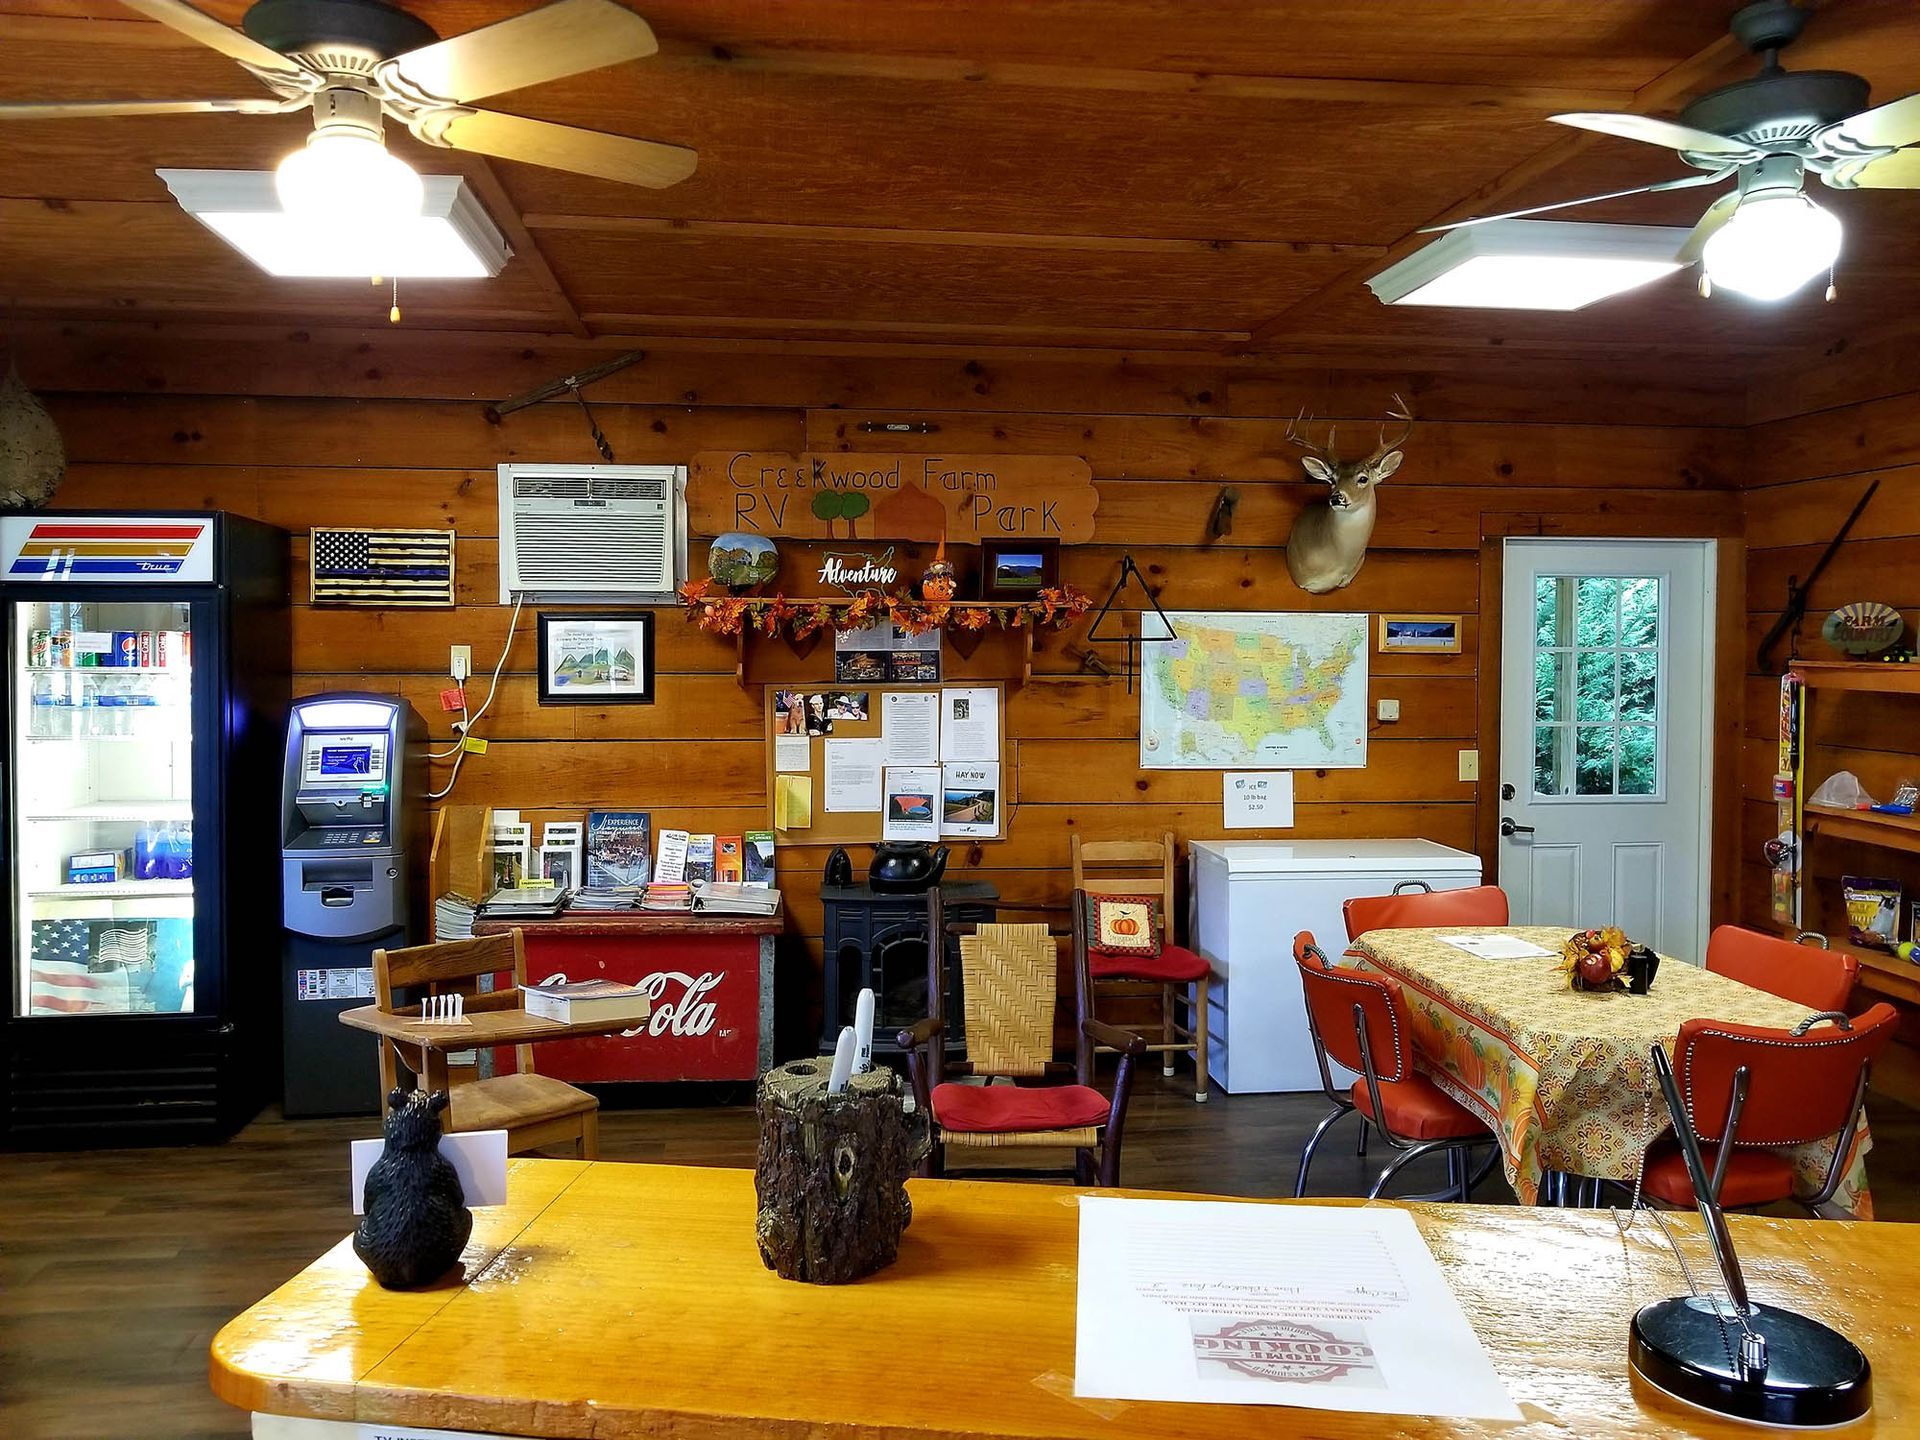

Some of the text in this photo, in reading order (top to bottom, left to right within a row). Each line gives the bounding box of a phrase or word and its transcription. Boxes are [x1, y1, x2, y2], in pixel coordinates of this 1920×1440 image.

[924, 459, 998, 491] Farm
[734, 493, 789, 530] RV
[817, 557, 898, 585] Adventure
[955, 771, 986, 779] HAY NOW
[1193, 1338, 1374, 1357] COOKING
[1249, 1351, 1322, 1362] HOME
